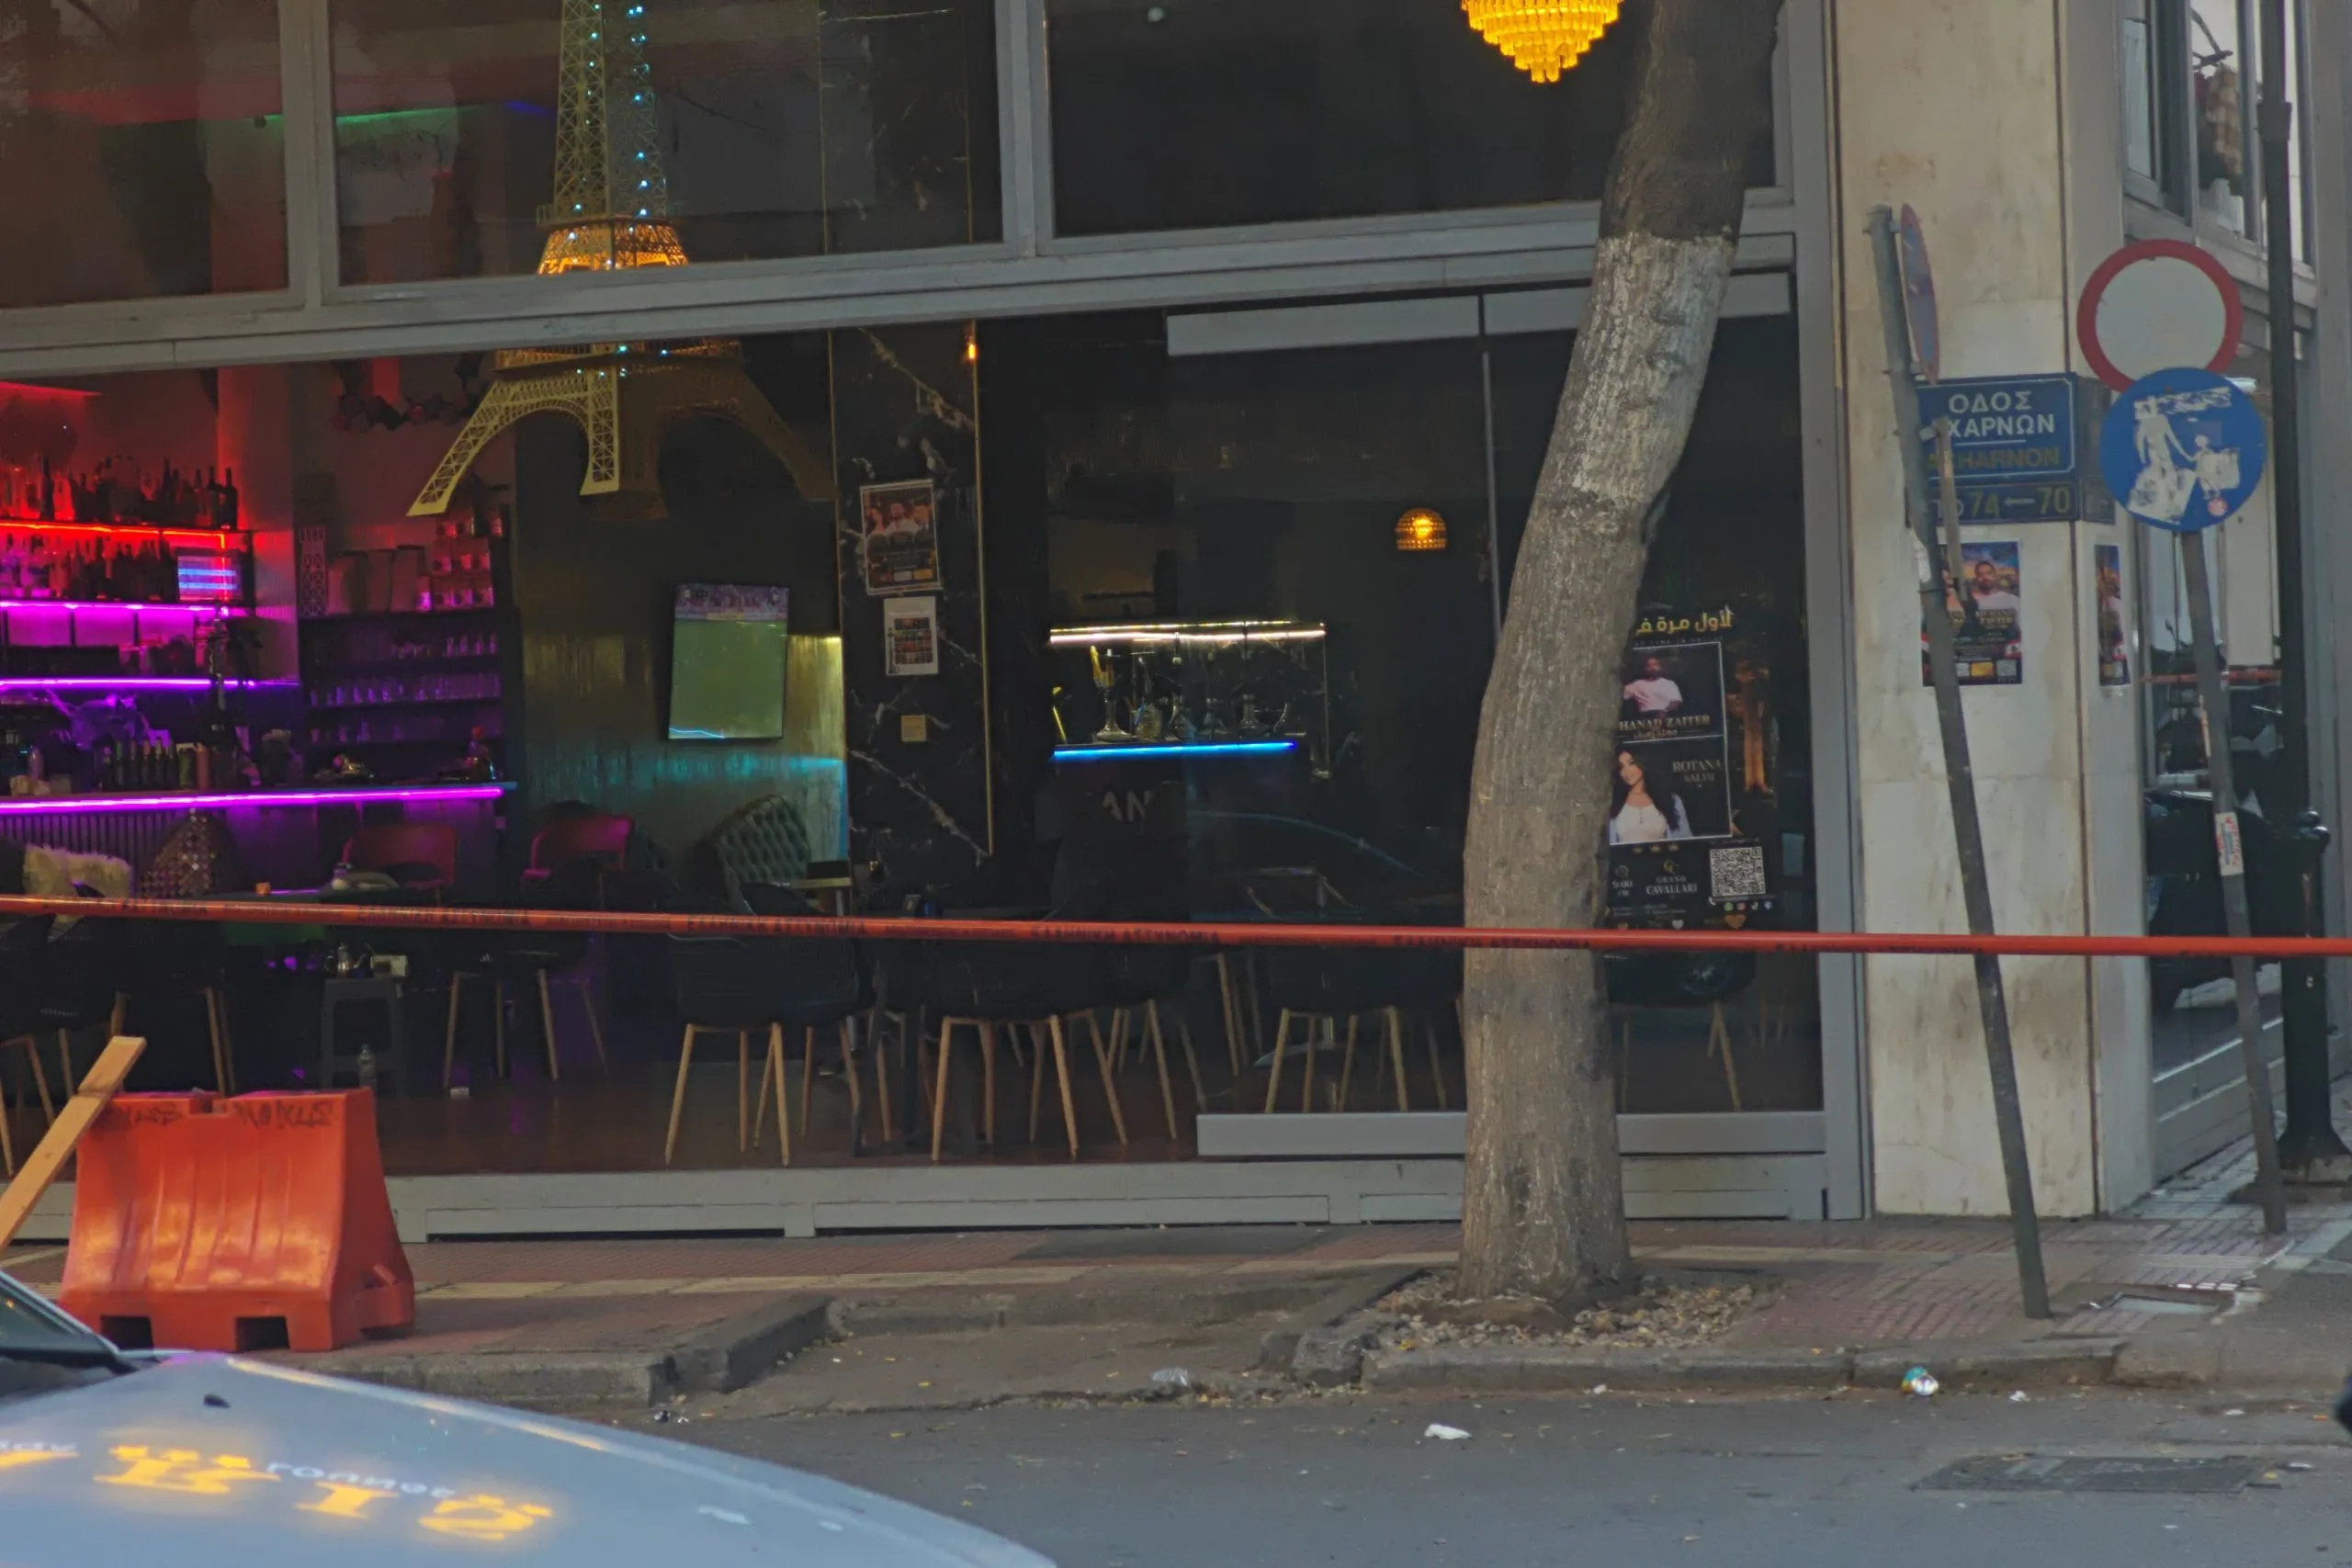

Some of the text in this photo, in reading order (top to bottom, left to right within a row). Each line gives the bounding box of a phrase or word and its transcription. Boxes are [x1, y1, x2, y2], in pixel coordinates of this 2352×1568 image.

[1948, 389, 2033, 414] ΟΔΟΣ
[1947, 413, 2055, 438] ΧΑΡΝΩΝ
[1928, 447, 2060, 470] HARNON
[1969, 491, 2000, 517] 74
[2037, 485, 2070, 516] 70
[1619, 718, 1664, 731] HANAD
[1645, 883, 1698, 896] CAVALLARI
